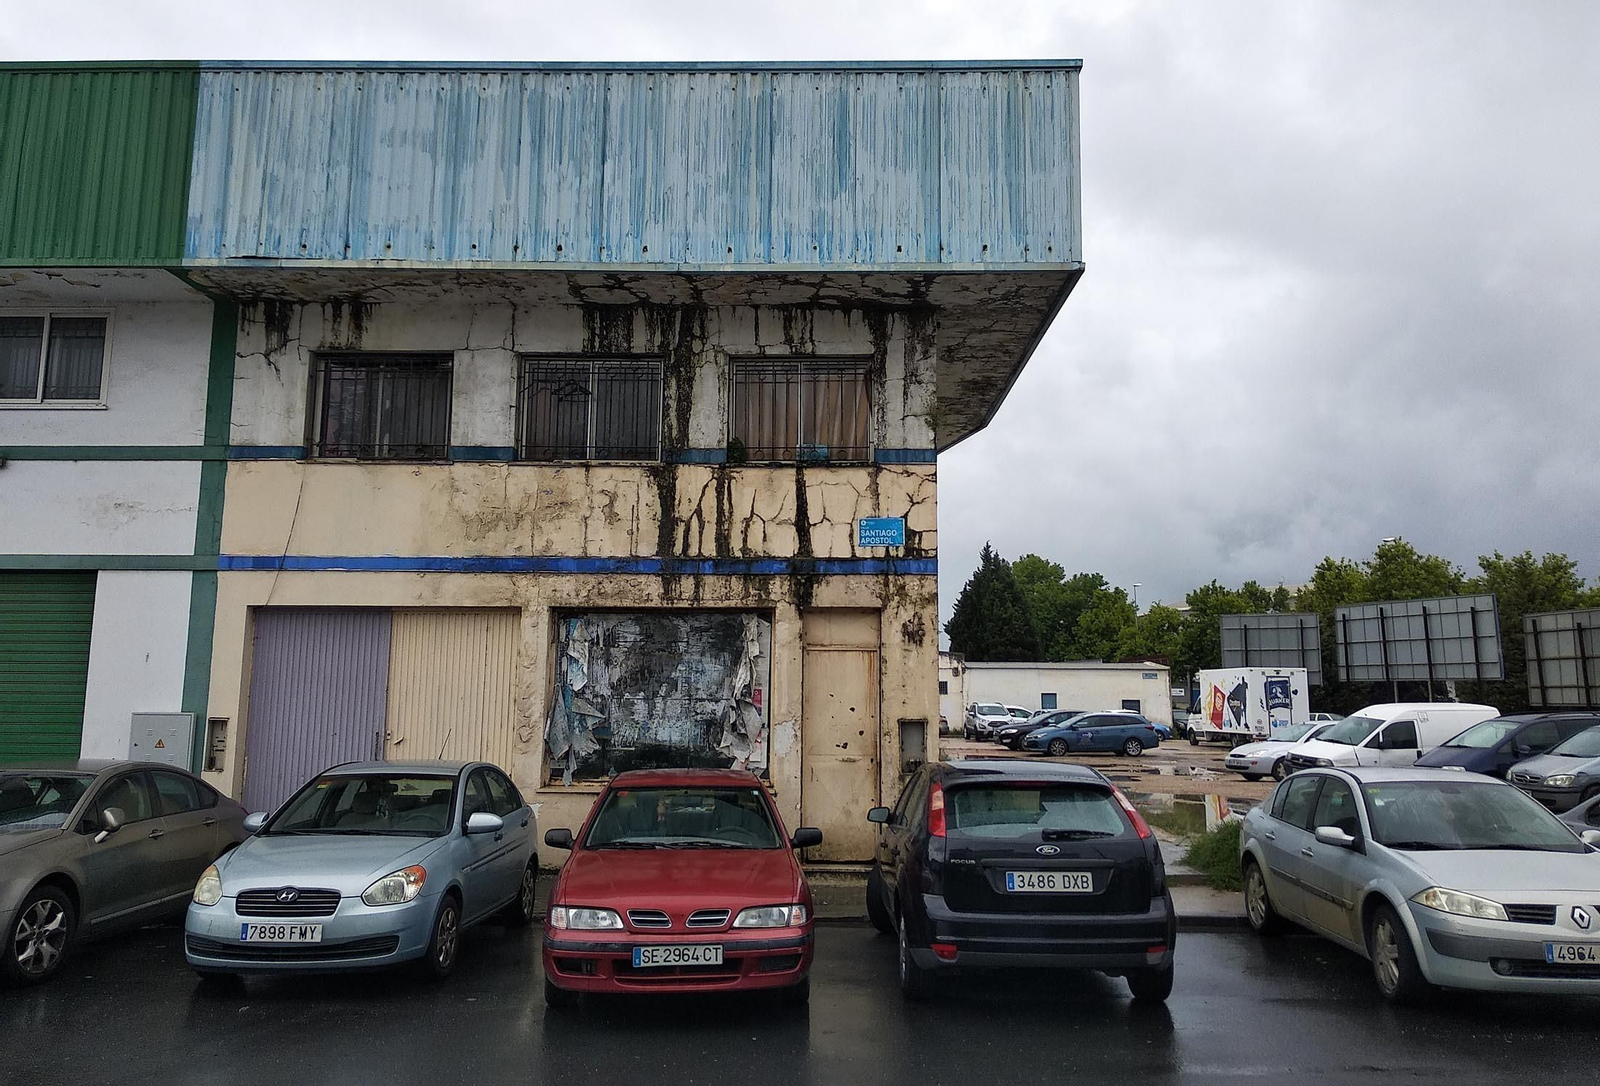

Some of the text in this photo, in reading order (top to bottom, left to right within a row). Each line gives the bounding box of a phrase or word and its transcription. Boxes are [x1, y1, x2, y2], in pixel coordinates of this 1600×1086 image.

[860, 529, 898, 537] SANTIAGO
[1017, 874, 1090, 890] 3486 DXB
[249, 925, 317, 940] 7898 FMY
[1557, 946, 1596, 962] 4964
